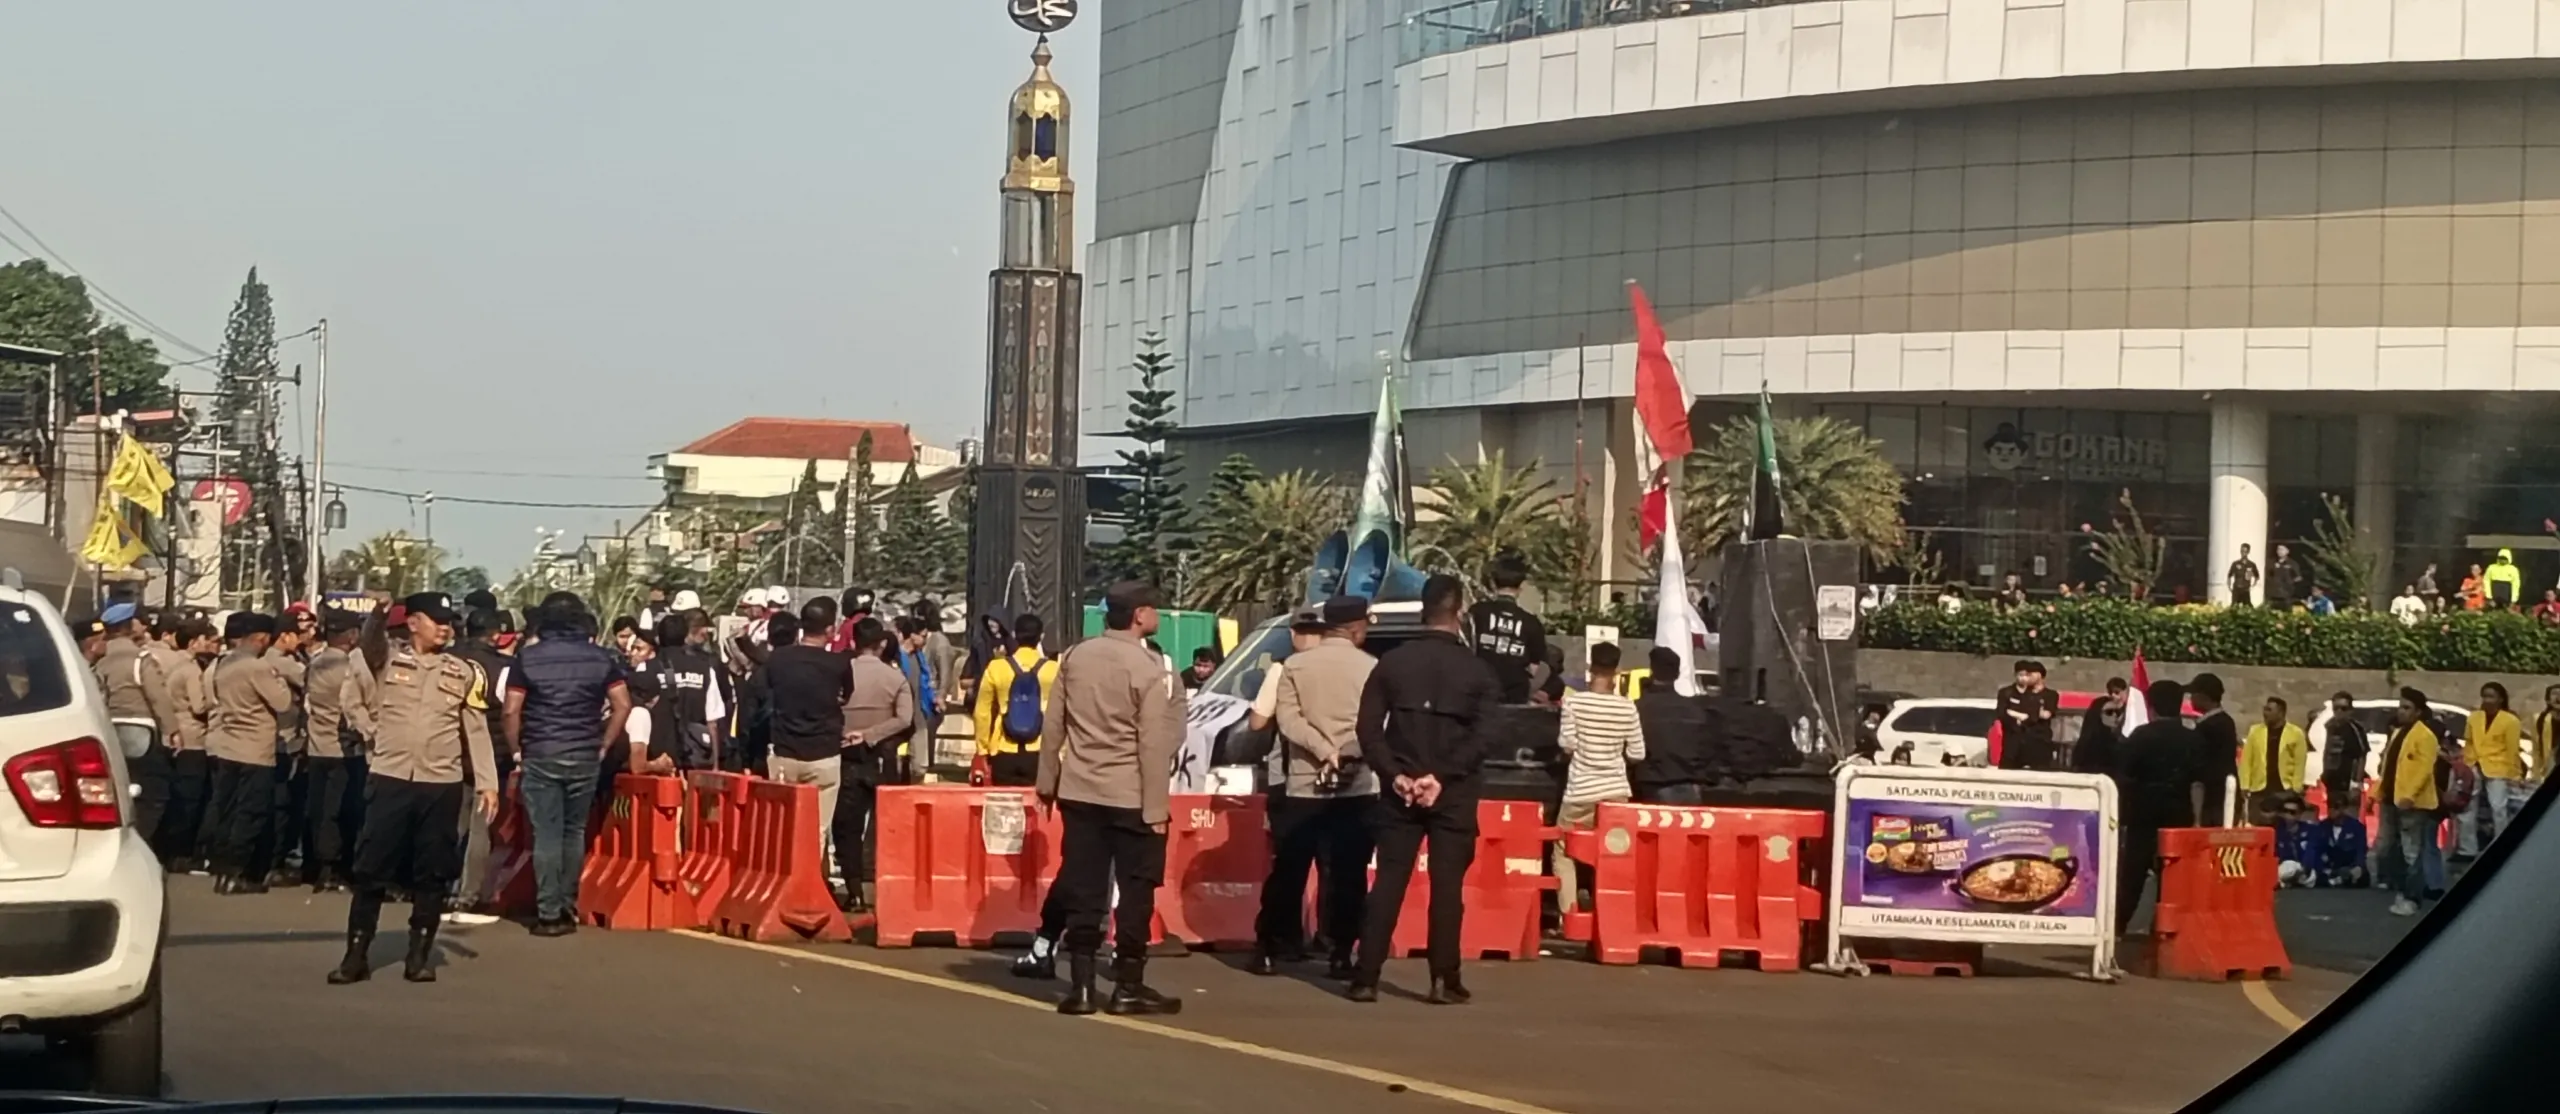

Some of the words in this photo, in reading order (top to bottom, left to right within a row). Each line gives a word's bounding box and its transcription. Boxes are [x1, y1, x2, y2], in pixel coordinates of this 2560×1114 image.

[2034, 431, 2168, 466] GOKANA
[1886, 786, 1948, 798] SATLANTAS
[1951, 788, 1996, 801] POLRES
[1935, 917, 2016, 930] KESELAMATAN
[2019, 921, 2031, 930] DI
[2032, 921, 2067, 931] JALAN
